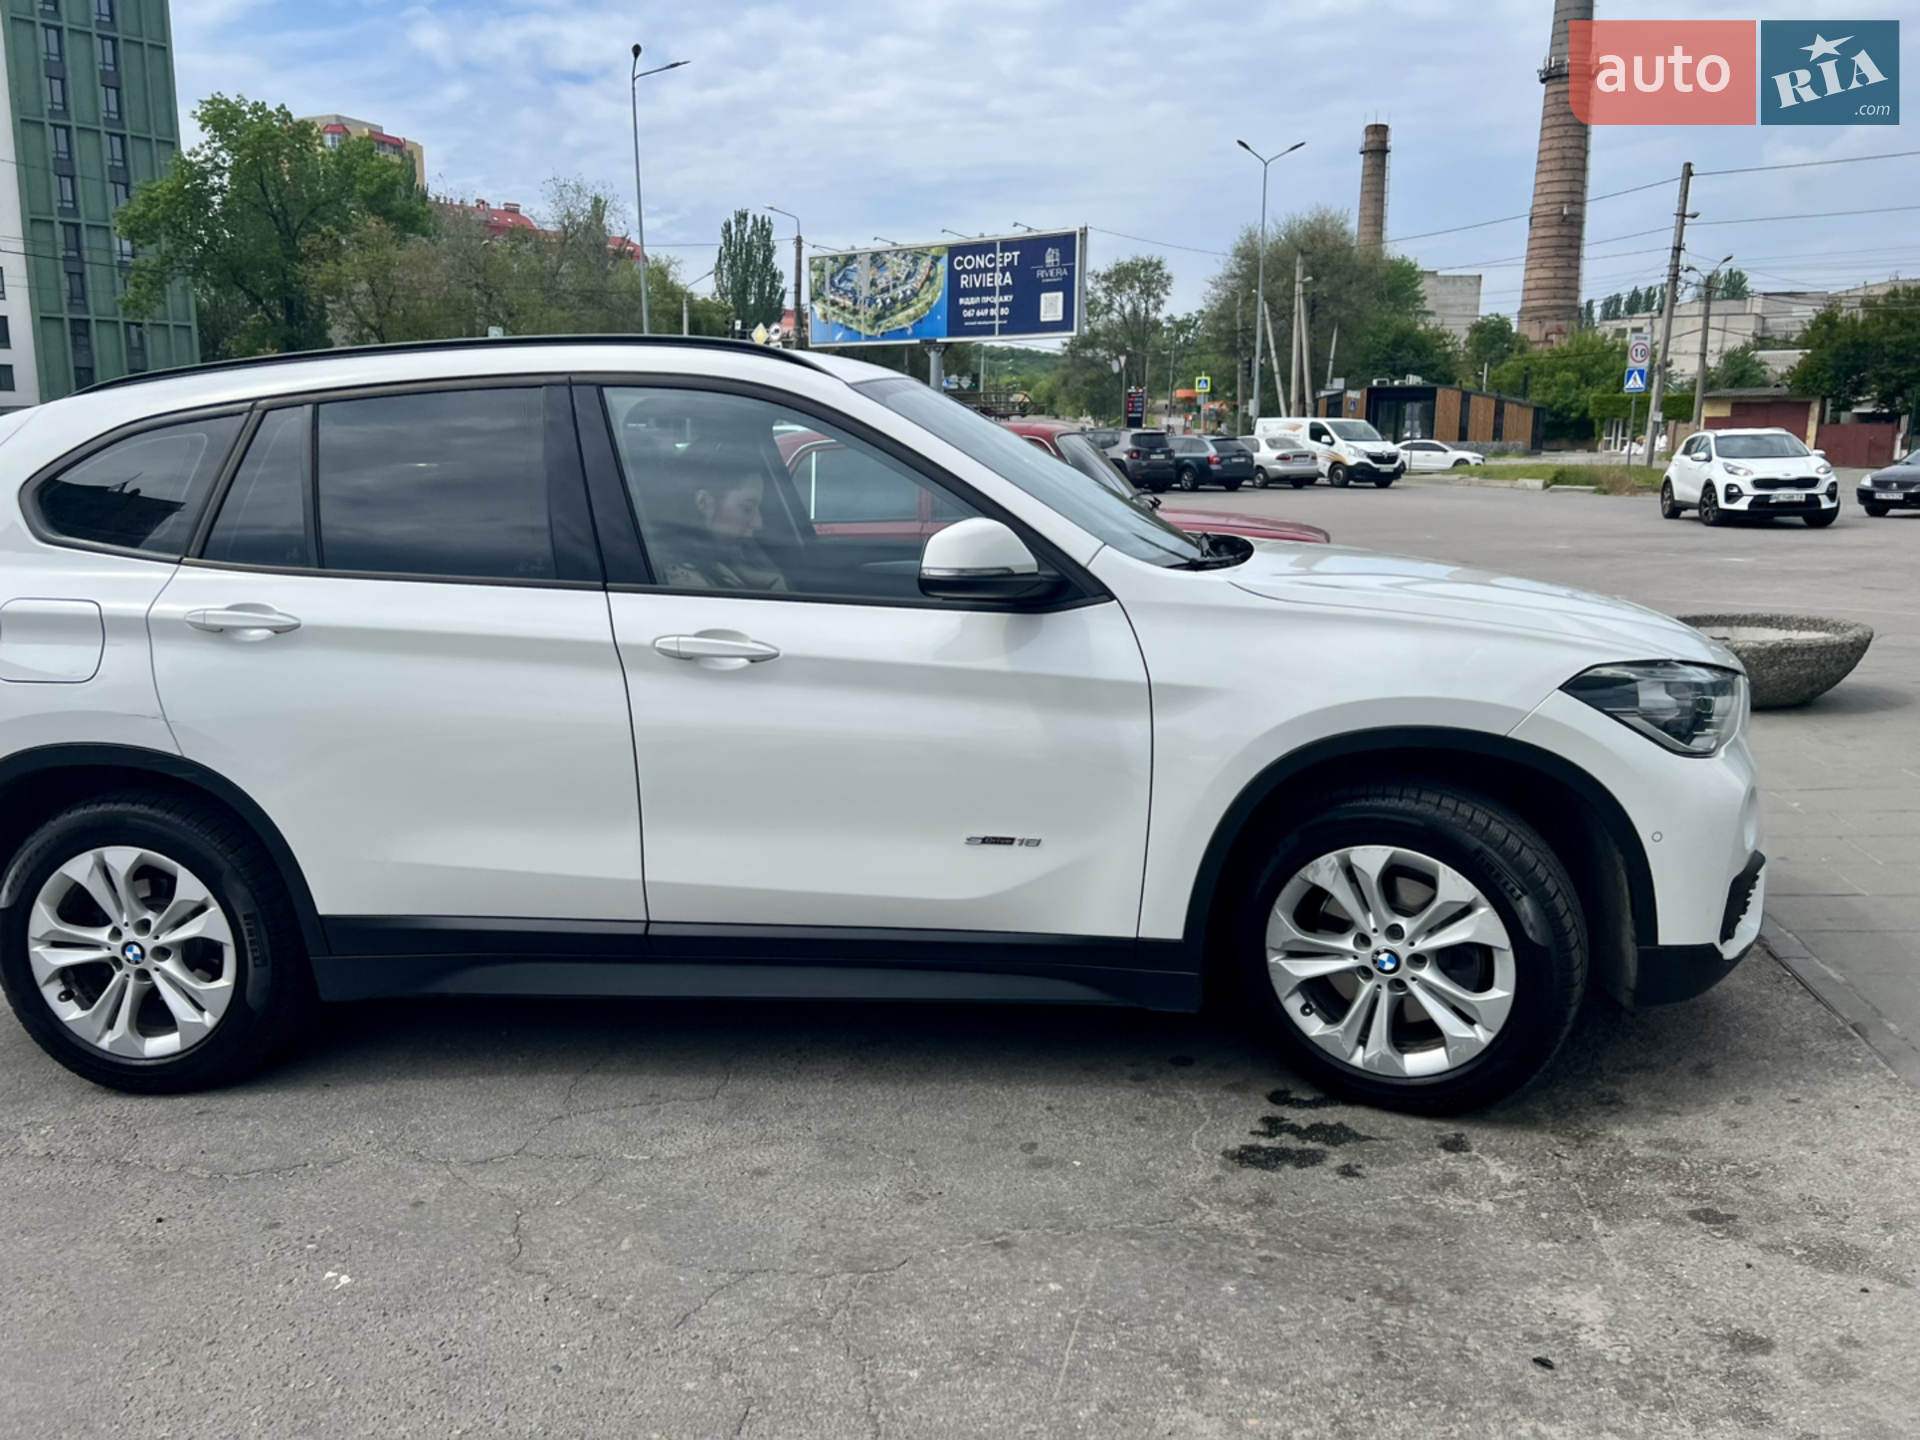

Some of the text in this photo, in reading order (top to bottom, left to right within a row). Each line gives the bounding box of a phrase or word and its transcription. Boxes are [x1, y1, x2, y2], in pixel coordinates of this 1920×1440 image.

[953, 251, 1021, 271] CONCEPT
[960, 271, 1013, 289] RIVIERA
[1634, 347, 1646, 358] 10
